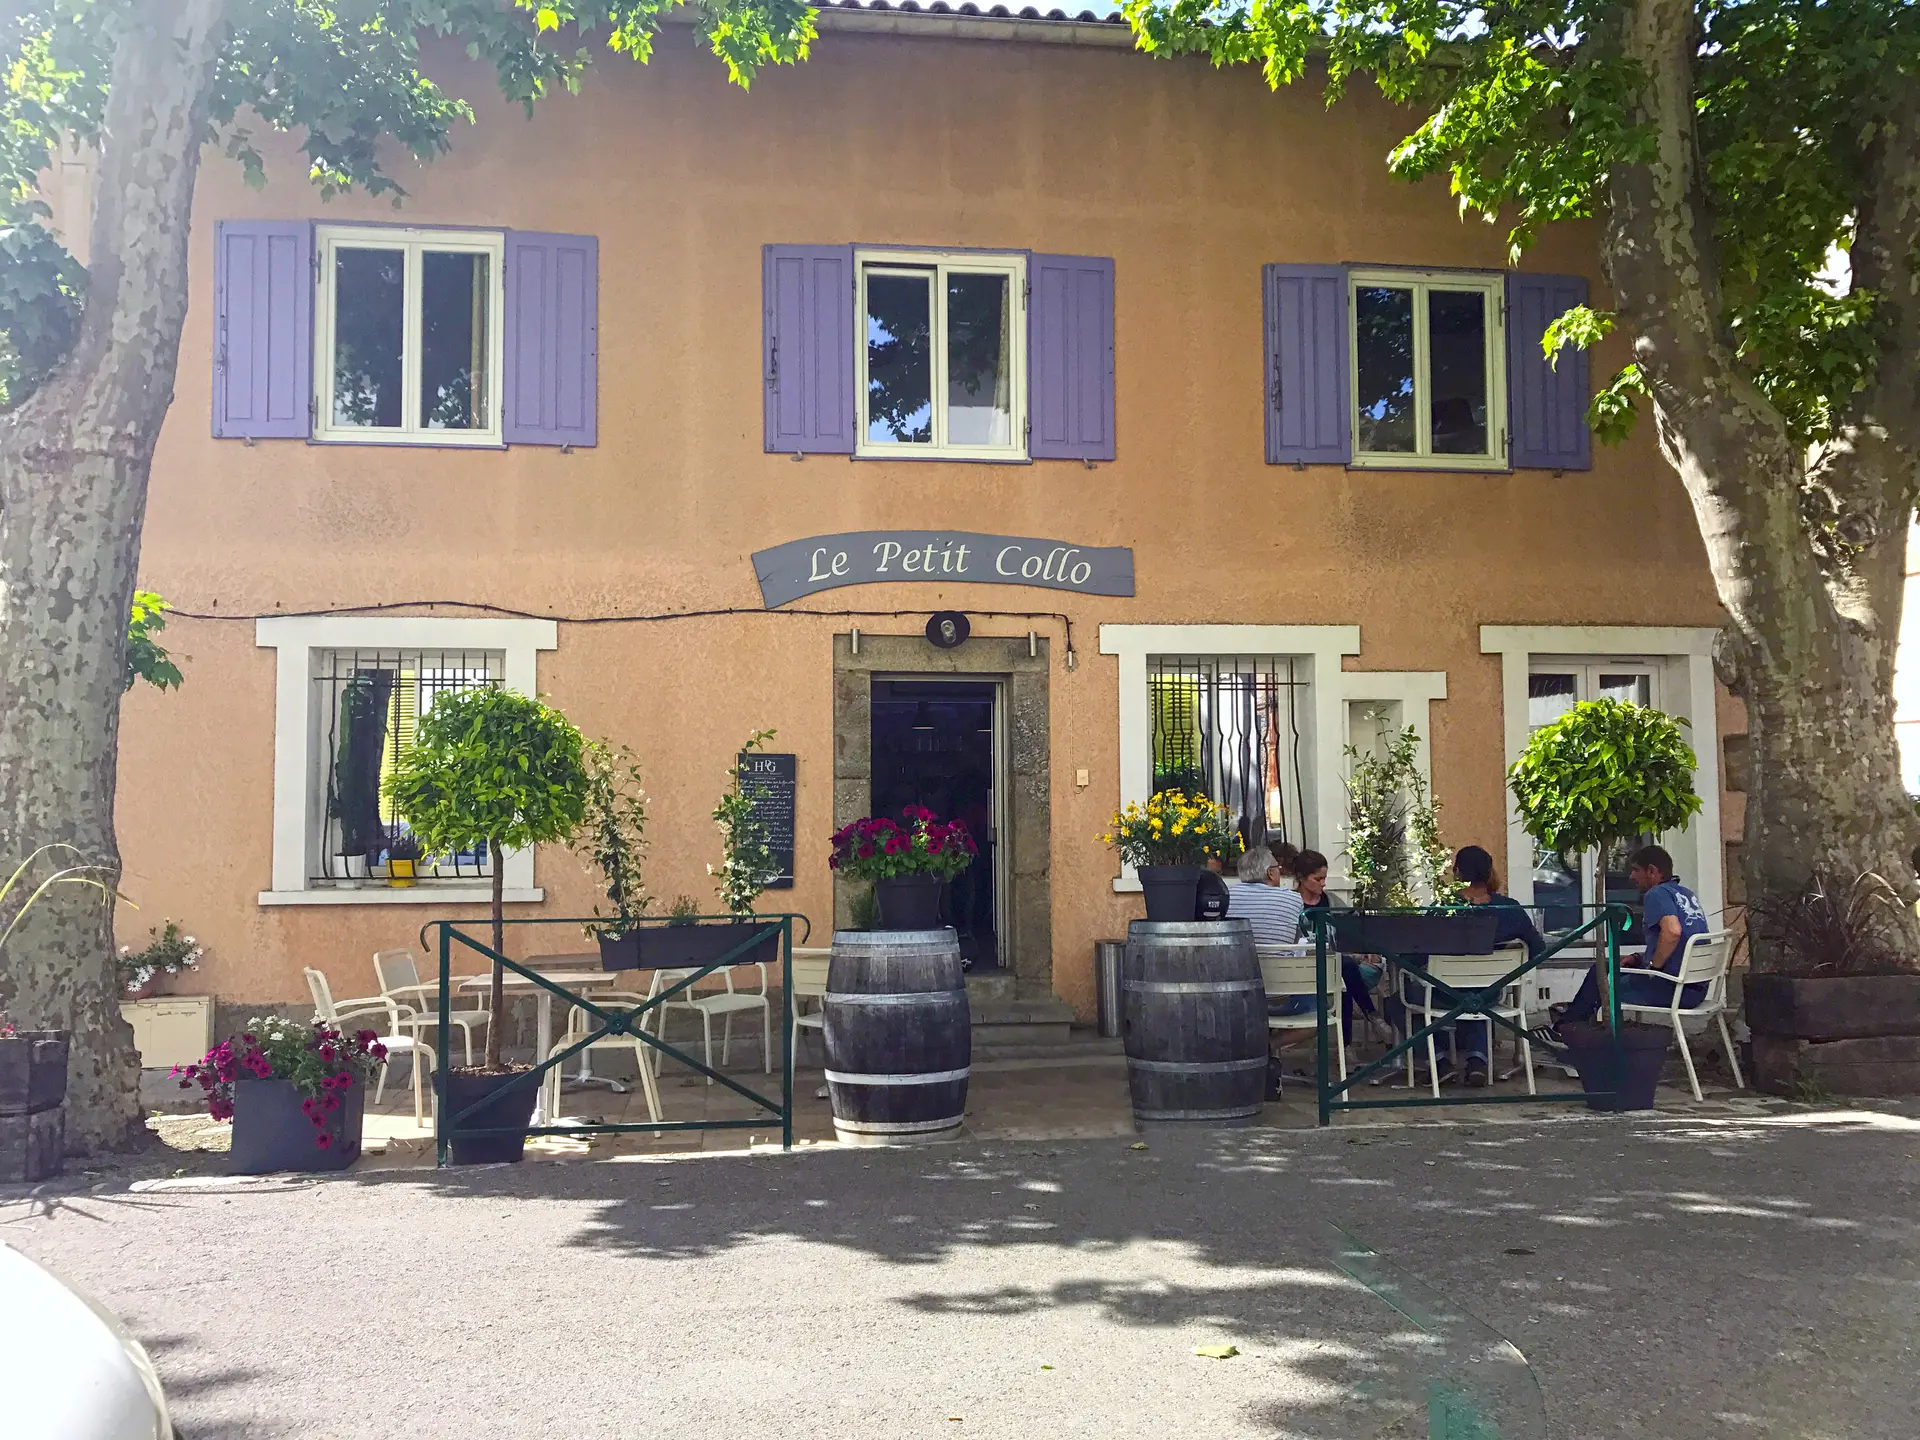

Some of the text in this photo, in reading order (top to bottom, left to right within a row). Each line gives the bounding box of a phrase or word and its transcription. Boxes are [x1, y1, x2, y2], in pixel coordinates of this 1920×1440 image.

[807, 539, 1092, 584] Le Petit Collo
